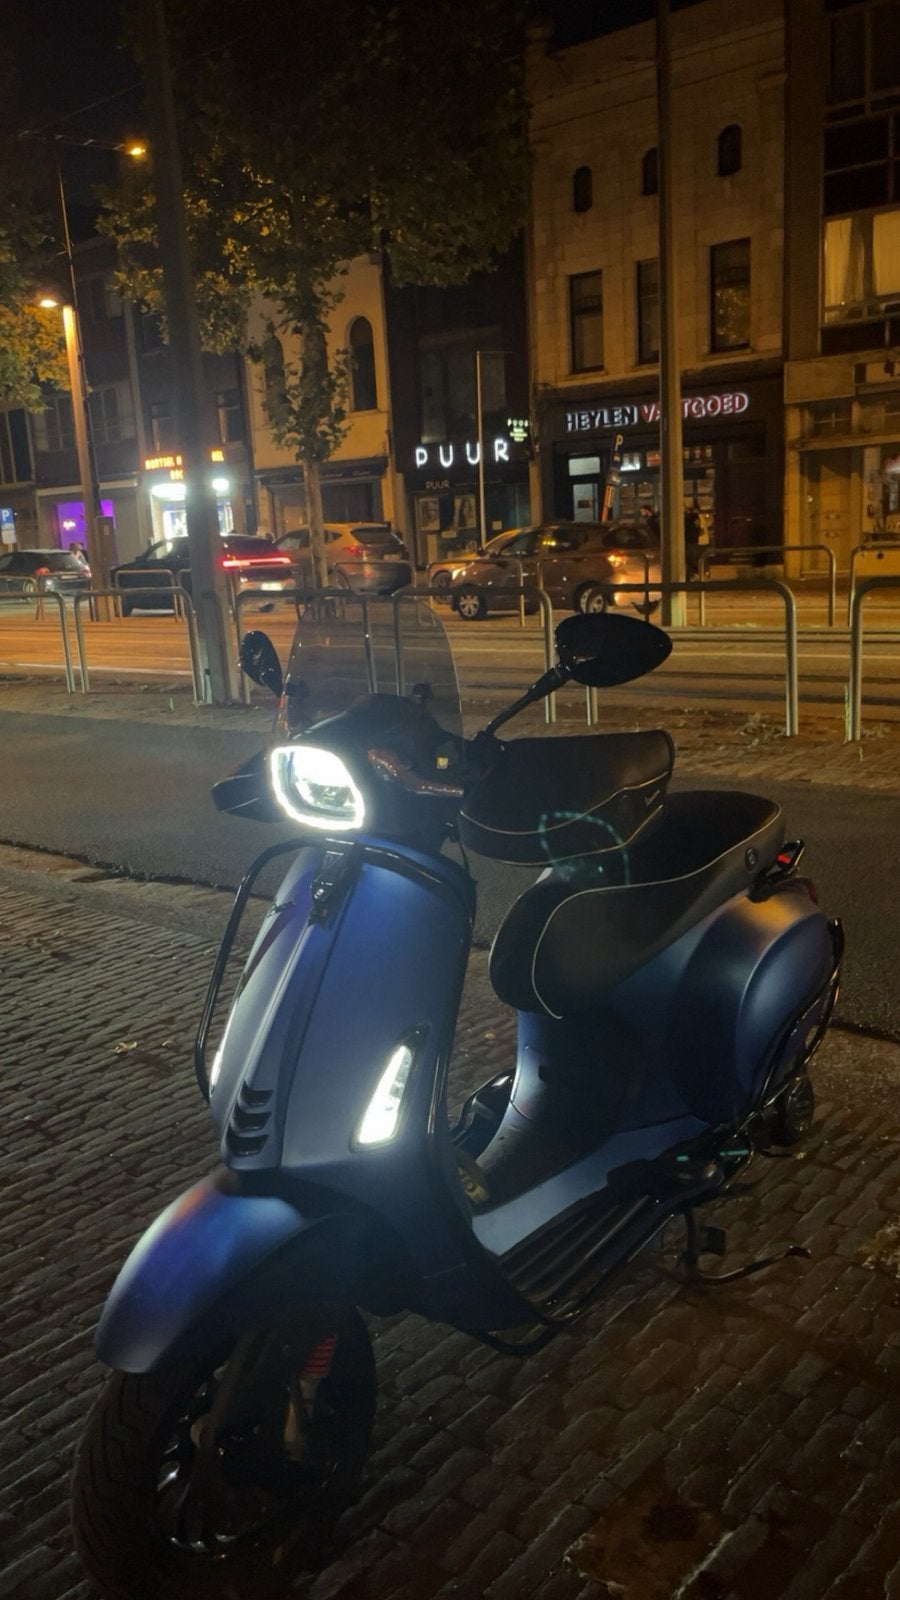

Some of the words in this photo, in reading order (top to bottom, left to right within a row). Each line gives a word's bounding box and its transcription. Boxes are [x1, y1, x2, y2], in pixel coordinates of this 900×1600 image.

[566, 405, 638, 432] HEYLEN
[640, 392, 749, 423] VTGOED
[415, 438, 509, 469] PUUR
[2, 509, 10, 522] P
